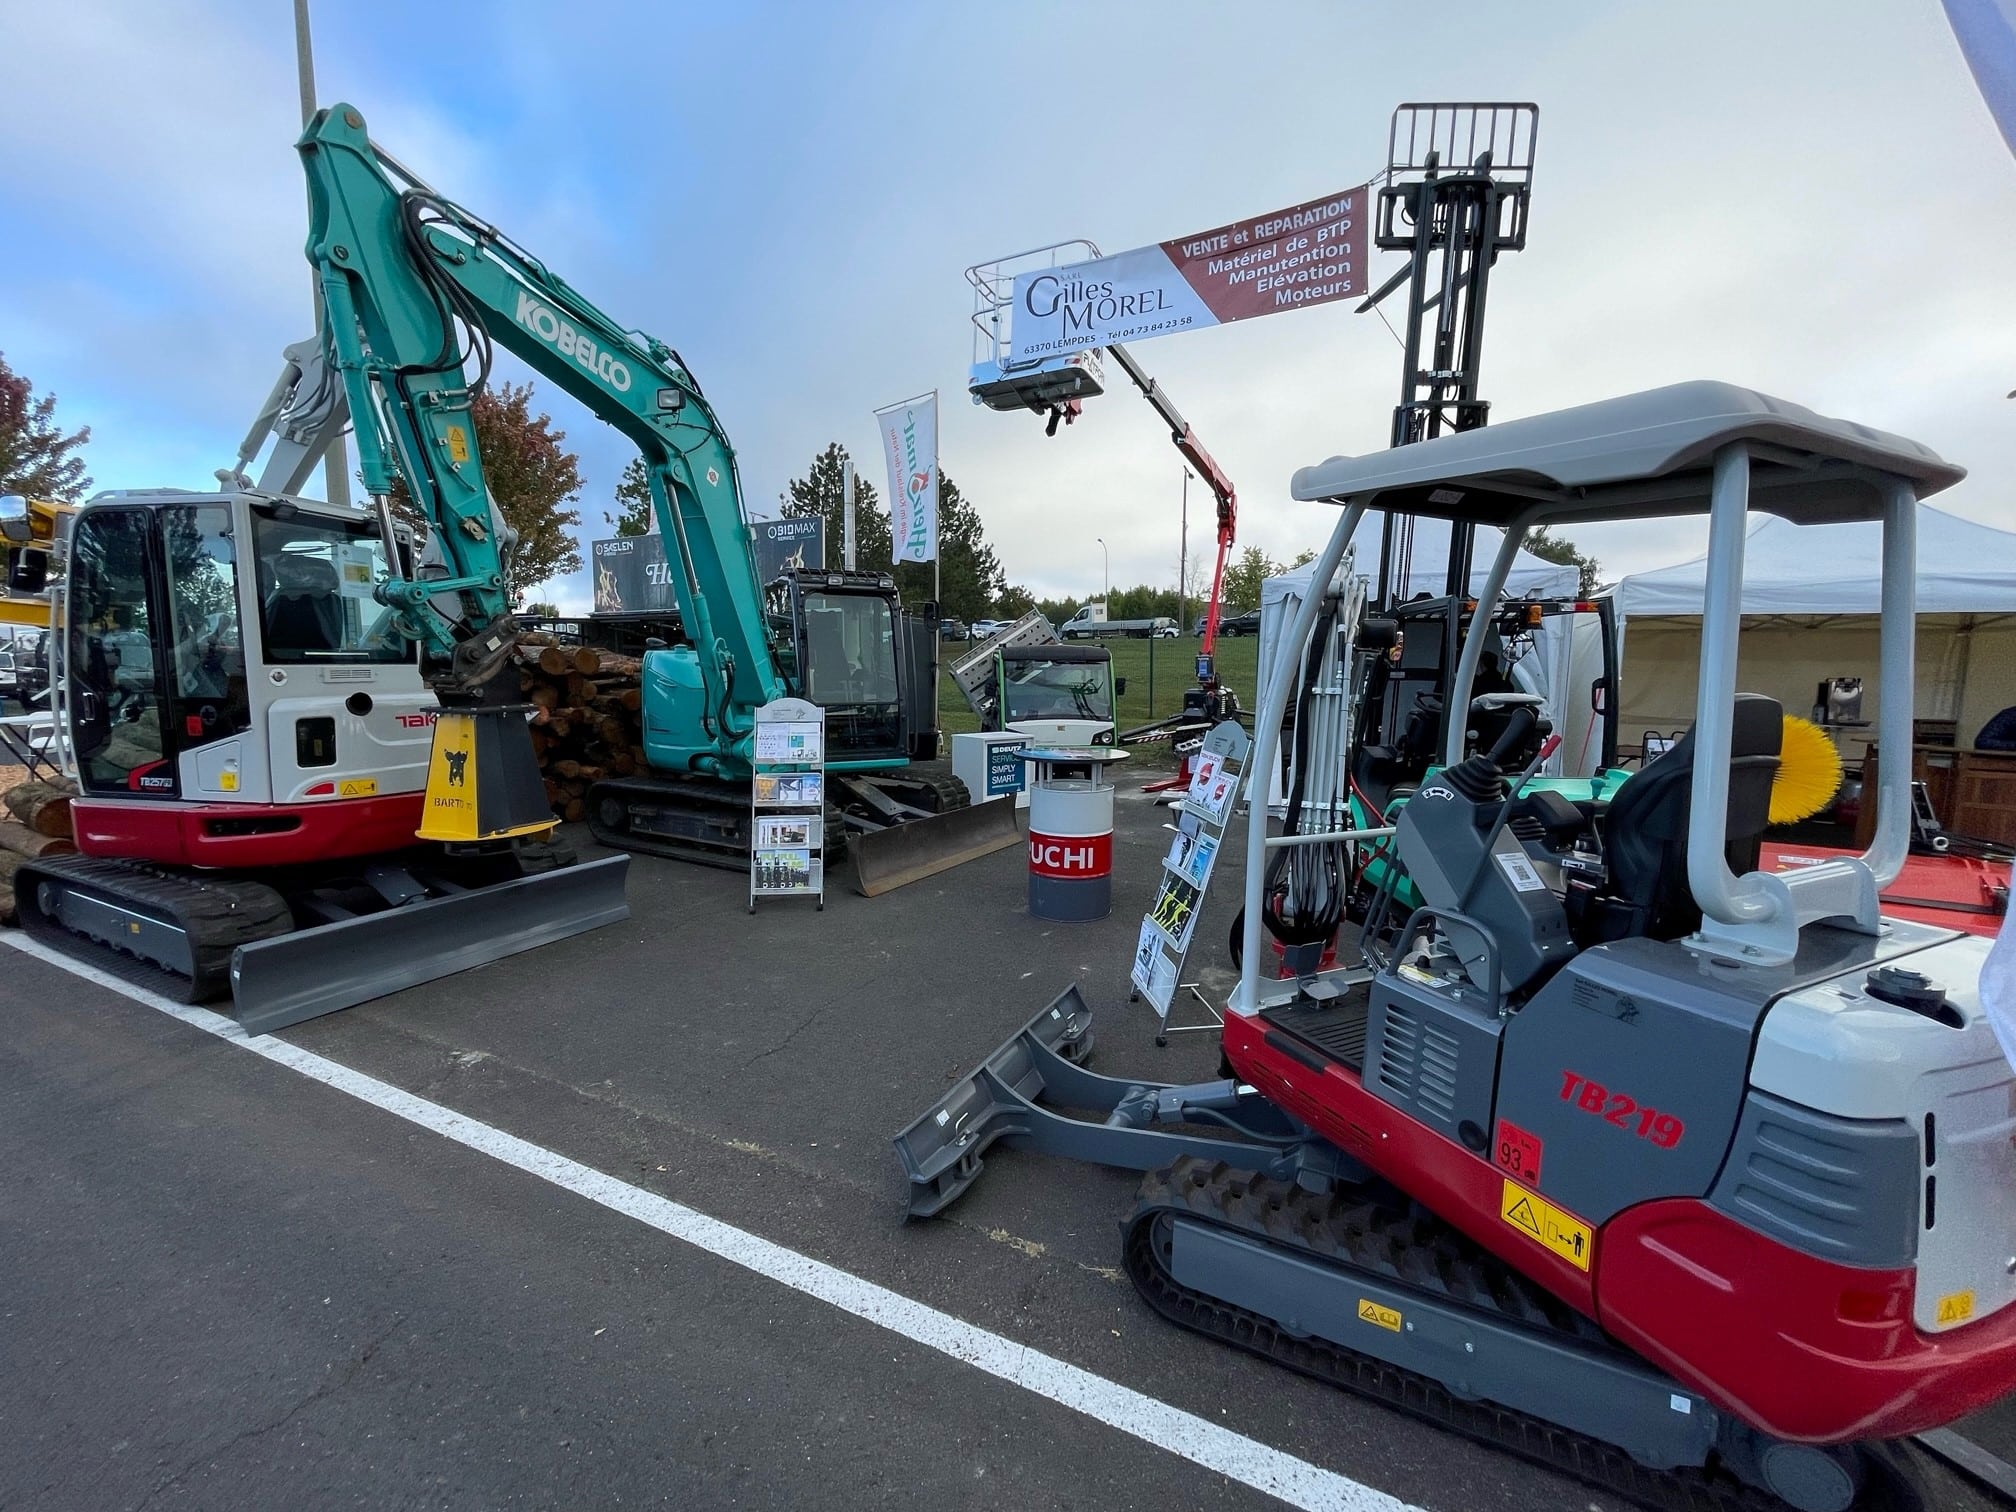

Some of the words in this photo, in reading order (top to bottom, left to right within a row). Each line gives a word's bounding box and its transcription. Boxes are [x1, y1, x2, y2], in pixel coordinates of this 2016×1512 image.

[1182, 234, 1228, 258] VENTE
[1234, 230, 1249, 245] et
[1255, 198, 1352, 239] REPARATION
[1208, 245, 1277, 276] Matériel
[1286, 236, 1308, 253] de
[1317, 220, 1351, 243] BTP
[1229, 243, 1351, 285] Manutention
[1025, 275, 1113, 318] Gilles
[1257, 261, 1351, 294] Elévation
[1276, 280, 1351, 306] Moteurs
[1062, 289, 1174, 339] MOREL
[515, 291, 631, 392] KOBELCO
[1024, 343, 1051, 355] 63370
[1053, 334, 1096, 349] LEMPDES
[1108, 331, 1121, 340] Tél
[1123, 328, 1135, 337] 04
[1137, 325, 1149, 334] 73
[1151, 322, 1163, 331] 84
[1165, 319, 1177, 329] 23
[1180, 316, 1193, 325] 58
[777, 522, 816, 536] BIOMAX
[992, 764, 1016, 774] SIMPLY
[992, 774, 1016, 785] SMART
[1029, 841, 1094, 870] UCHI
[1559, 1068, 1684, 1149] TB219
[1500, 1142, 1521, 1171] 93
